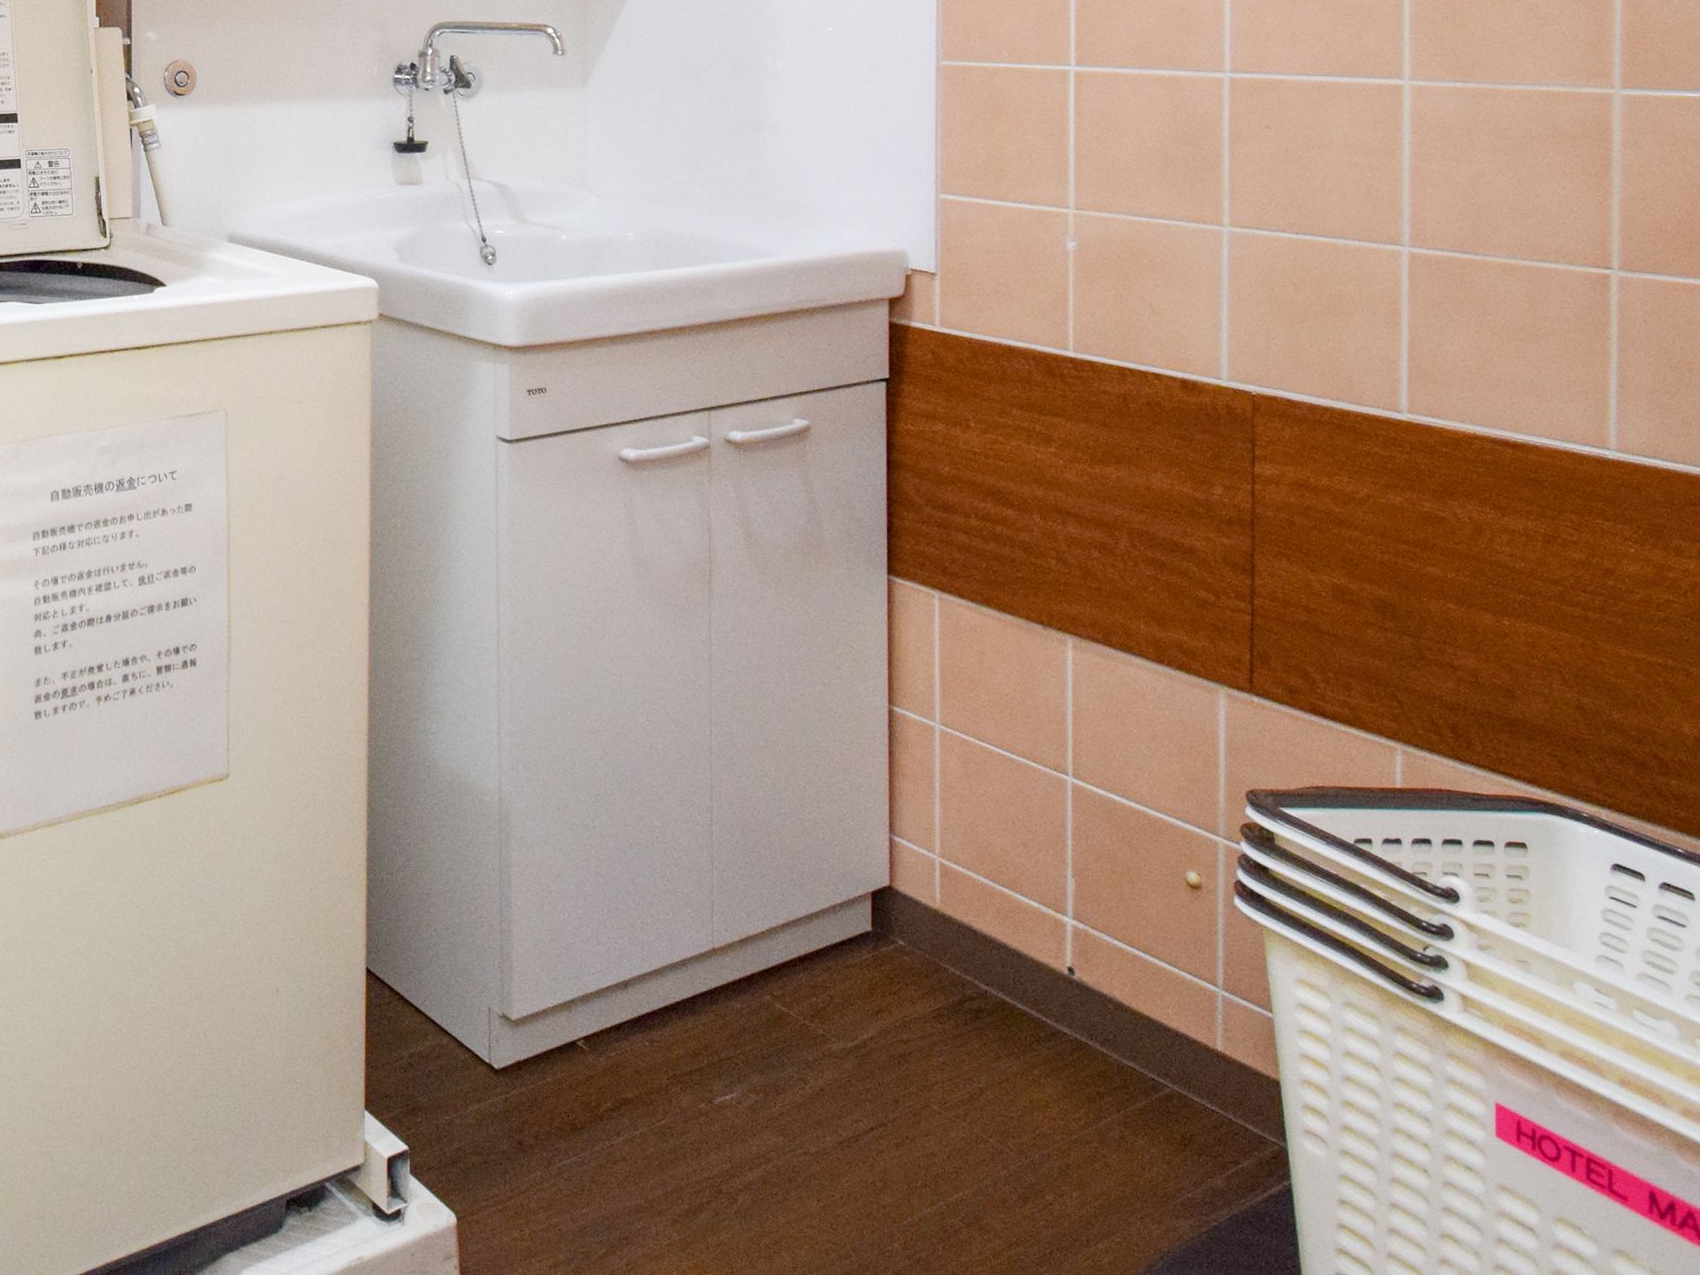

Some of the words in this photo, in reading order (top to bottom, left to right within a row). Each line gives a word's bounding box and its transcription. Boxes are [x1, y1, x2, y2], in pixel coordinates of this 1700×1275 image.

[526, 387, 547, 397] TOTO
[50, 470, 178, 502] 自動販売機の返金について
[1515, 1120, 1629, 1202] HOTEL
